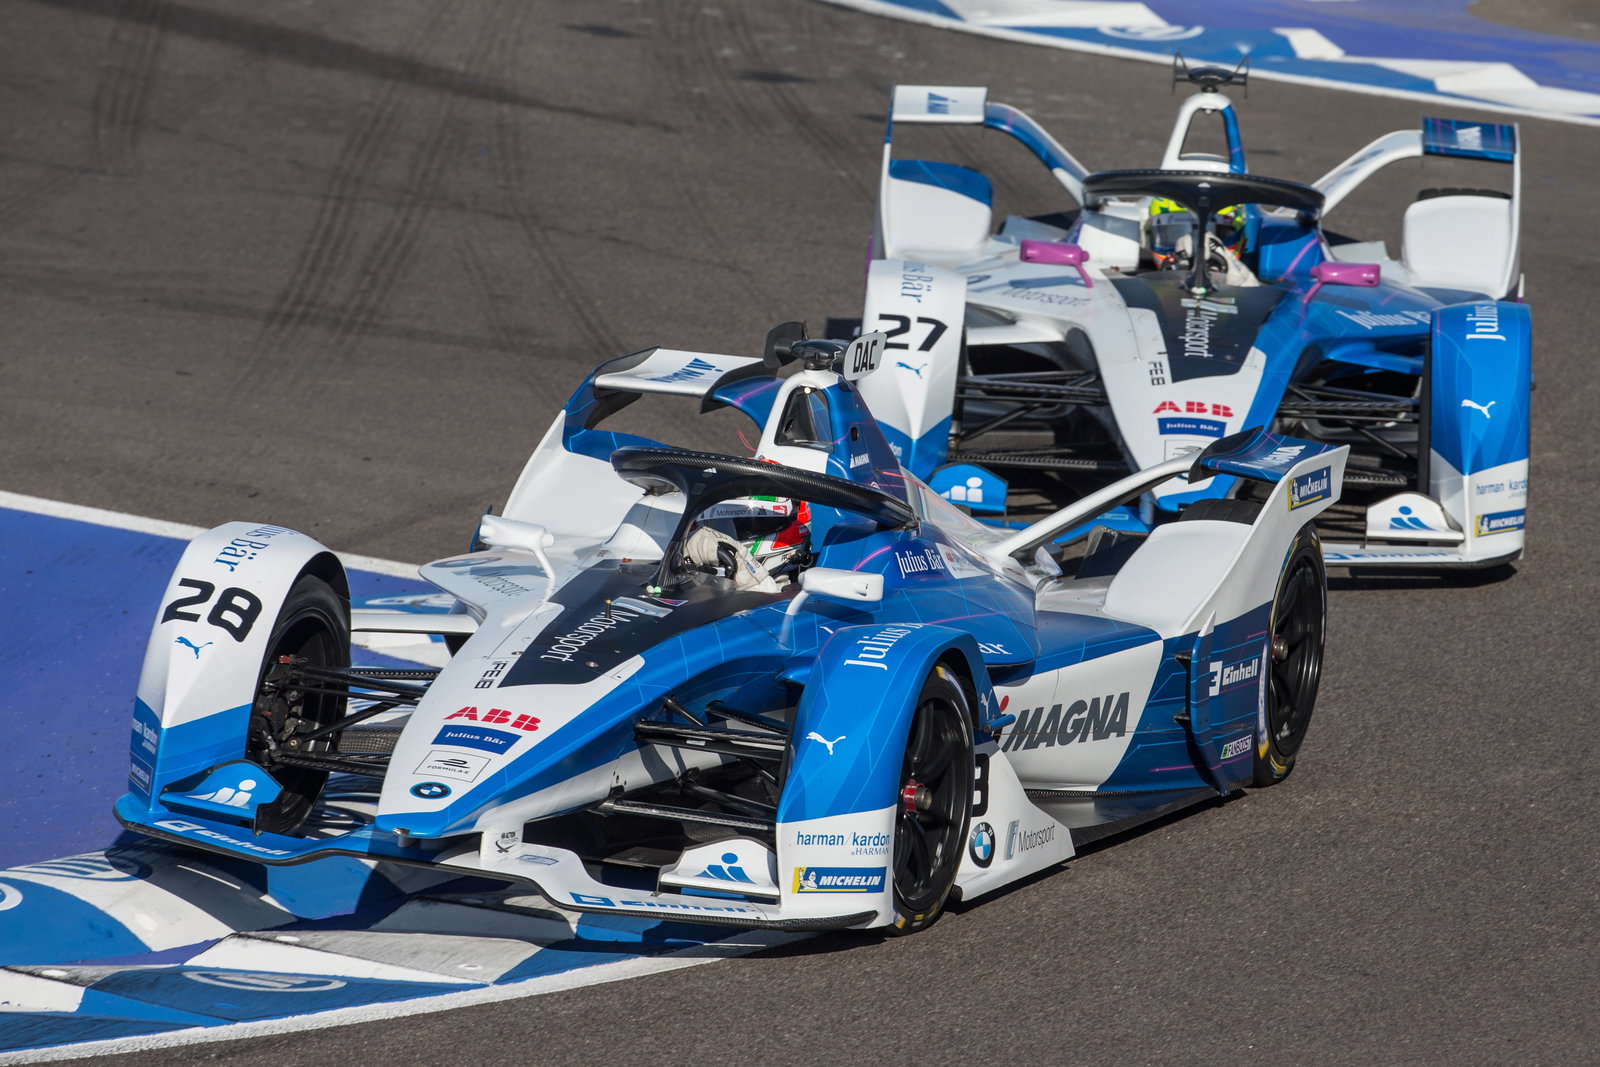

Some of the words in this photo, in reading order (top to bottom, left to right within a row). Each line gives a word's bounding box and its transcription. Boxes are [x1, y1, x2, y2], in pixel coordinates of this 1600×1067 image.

[878, 313, 949, 352] 27
[852, 339, 878, 374] DAC
[1152, 401, 1234, 418] ABB
[1300, 470, 1328, 498] MICHELIN
[895, 551, 929, 579] Julius
[160, 577, 262, 643] 28
[844, 627, 912, 671] Julius
[443, 706, 542, 732] ABB
[1001, 691, 1130, 753] MAGNA
[444, 731, 481, 741] Julius
[483, 735, 507, 745] Bär
[1018, 822, 1056, 853] Motorsport
[819, 875, 882, 886] MICHELIN
